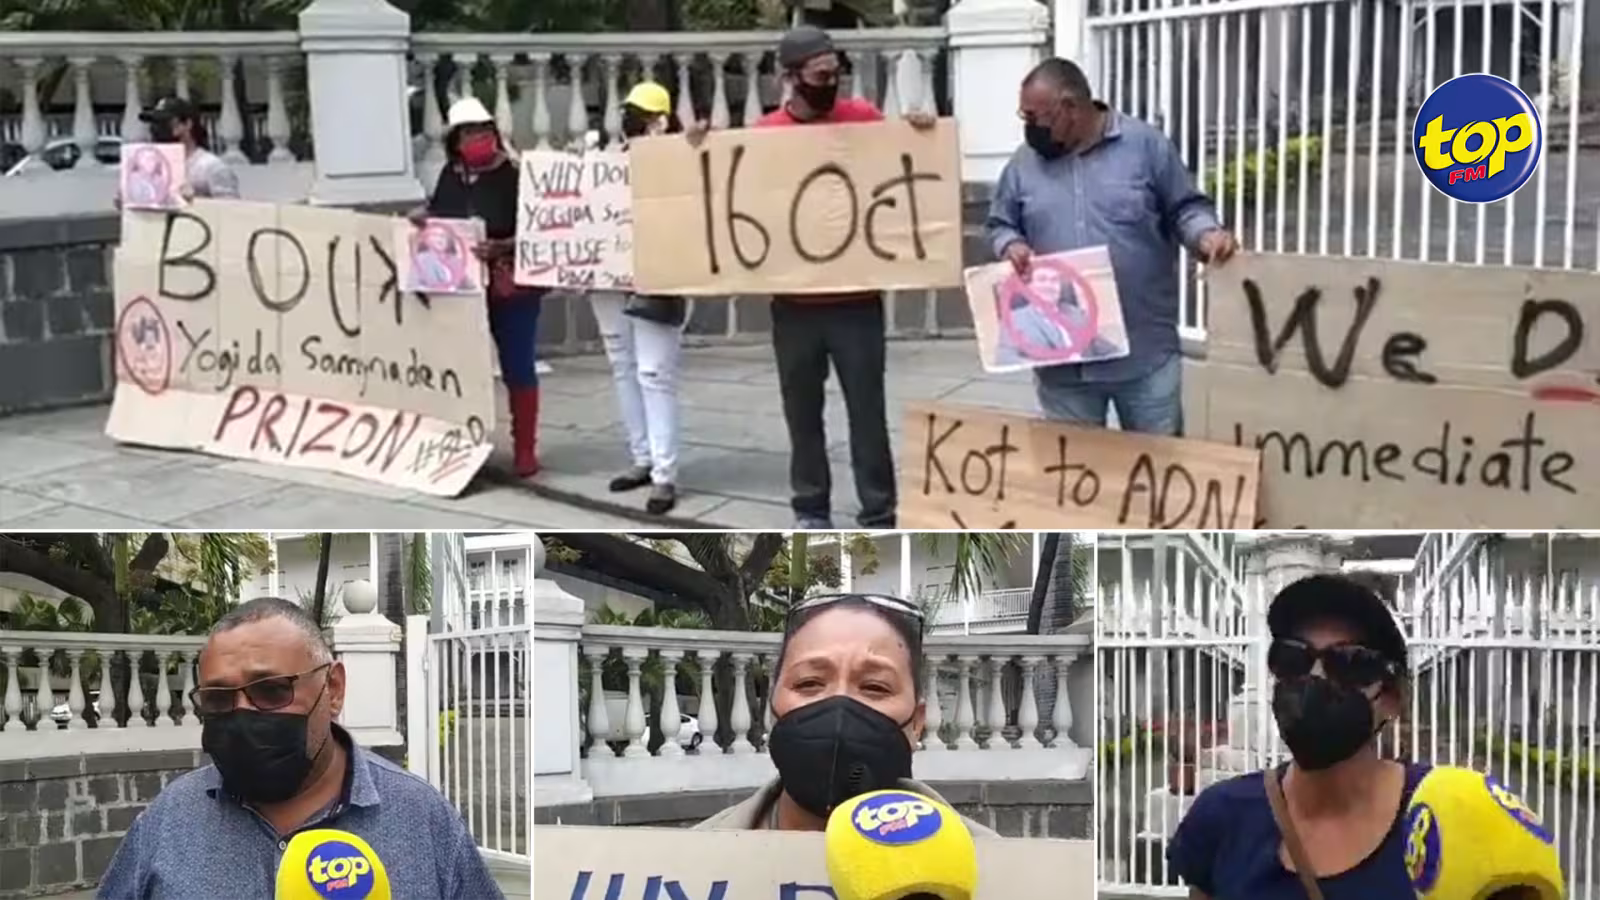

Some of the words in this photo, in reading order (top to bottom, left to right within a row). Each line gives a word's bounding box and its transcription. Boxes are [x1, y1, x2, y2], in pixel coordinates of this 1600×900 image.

[526, 160, 585, 195] WHY
[700, 144, 771, 275] 16
[789, 153, 942, 264] Oct
[177, 320, 281, 391] Yogida
[1243, 277, 1438, 389] We
[1511, 298, 1600, 384] D
[214, 385, 422, 473] PRIZON
[923, 413, 1020, 500] Kot
[1044, 435, 1101, 506] to
[855, 800, 934, 831] top
[309, 855, 370, 888] top
